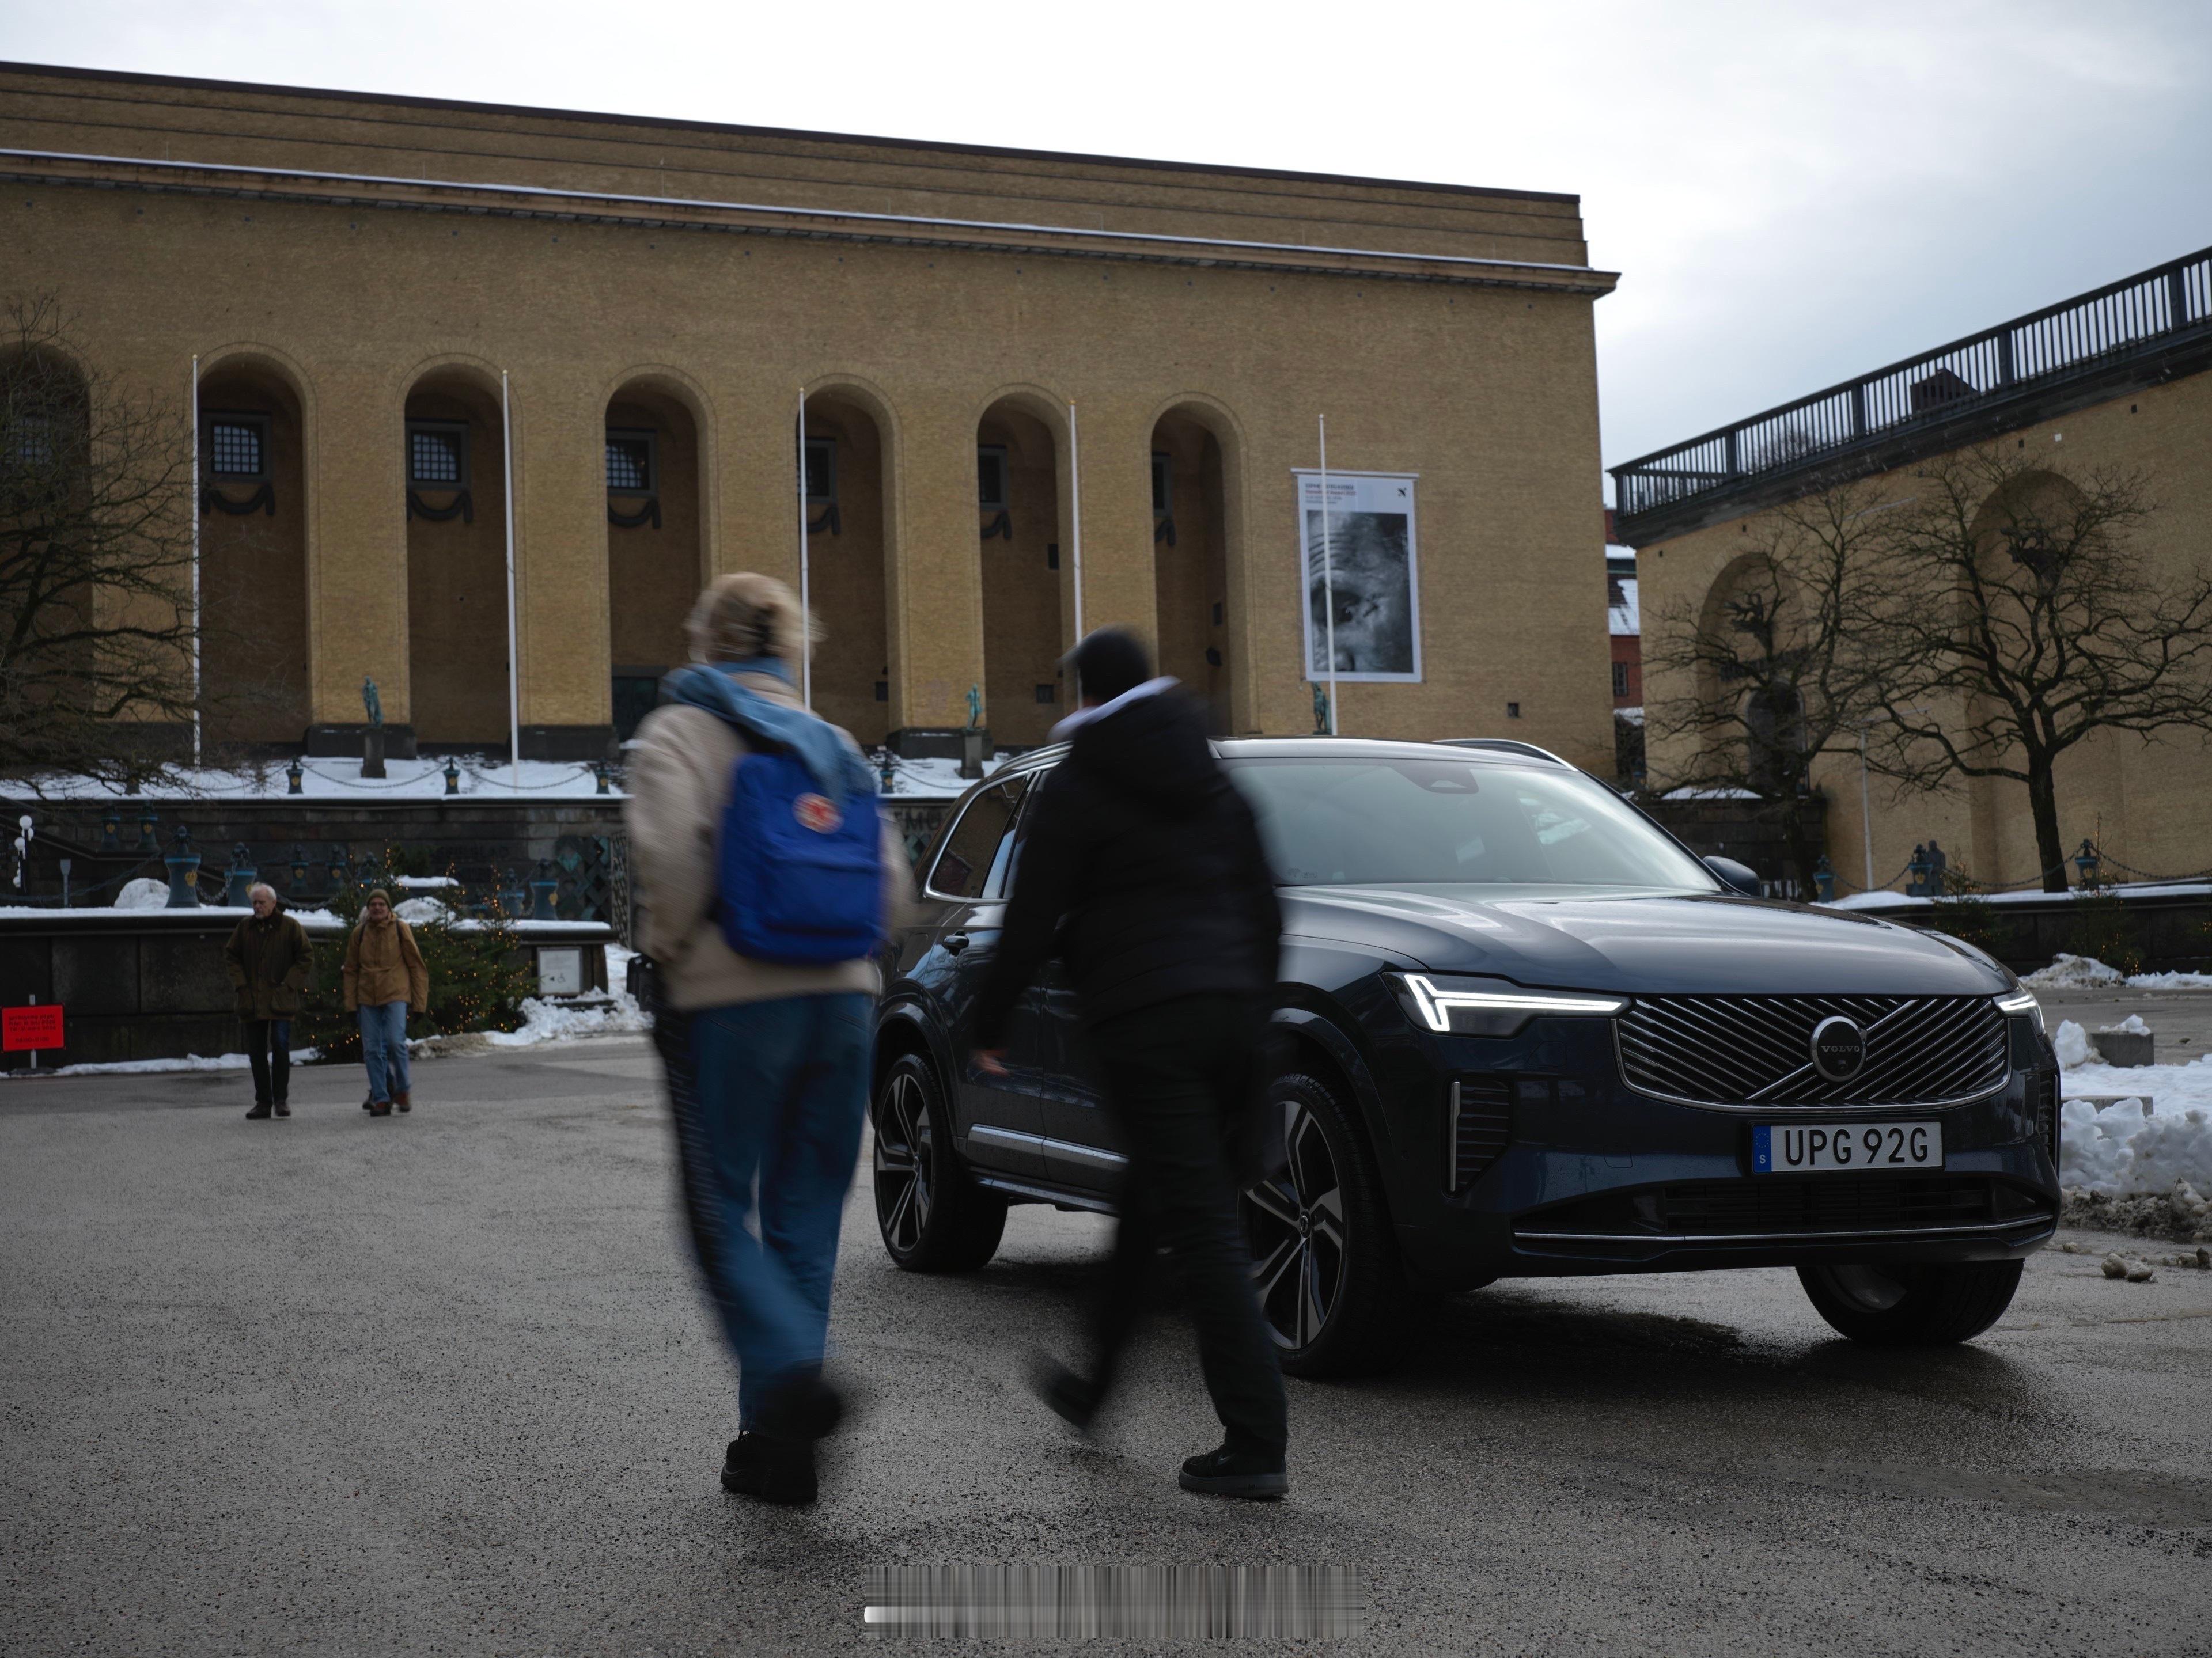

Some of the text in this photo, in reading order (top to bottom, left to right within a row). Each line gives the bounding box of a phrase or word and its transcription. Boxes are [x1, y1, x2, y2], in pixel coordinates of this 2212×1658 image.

[1785, 1127, 1928, 1166] UPG 92G
[1759, 1154, 1766, 1164] S
